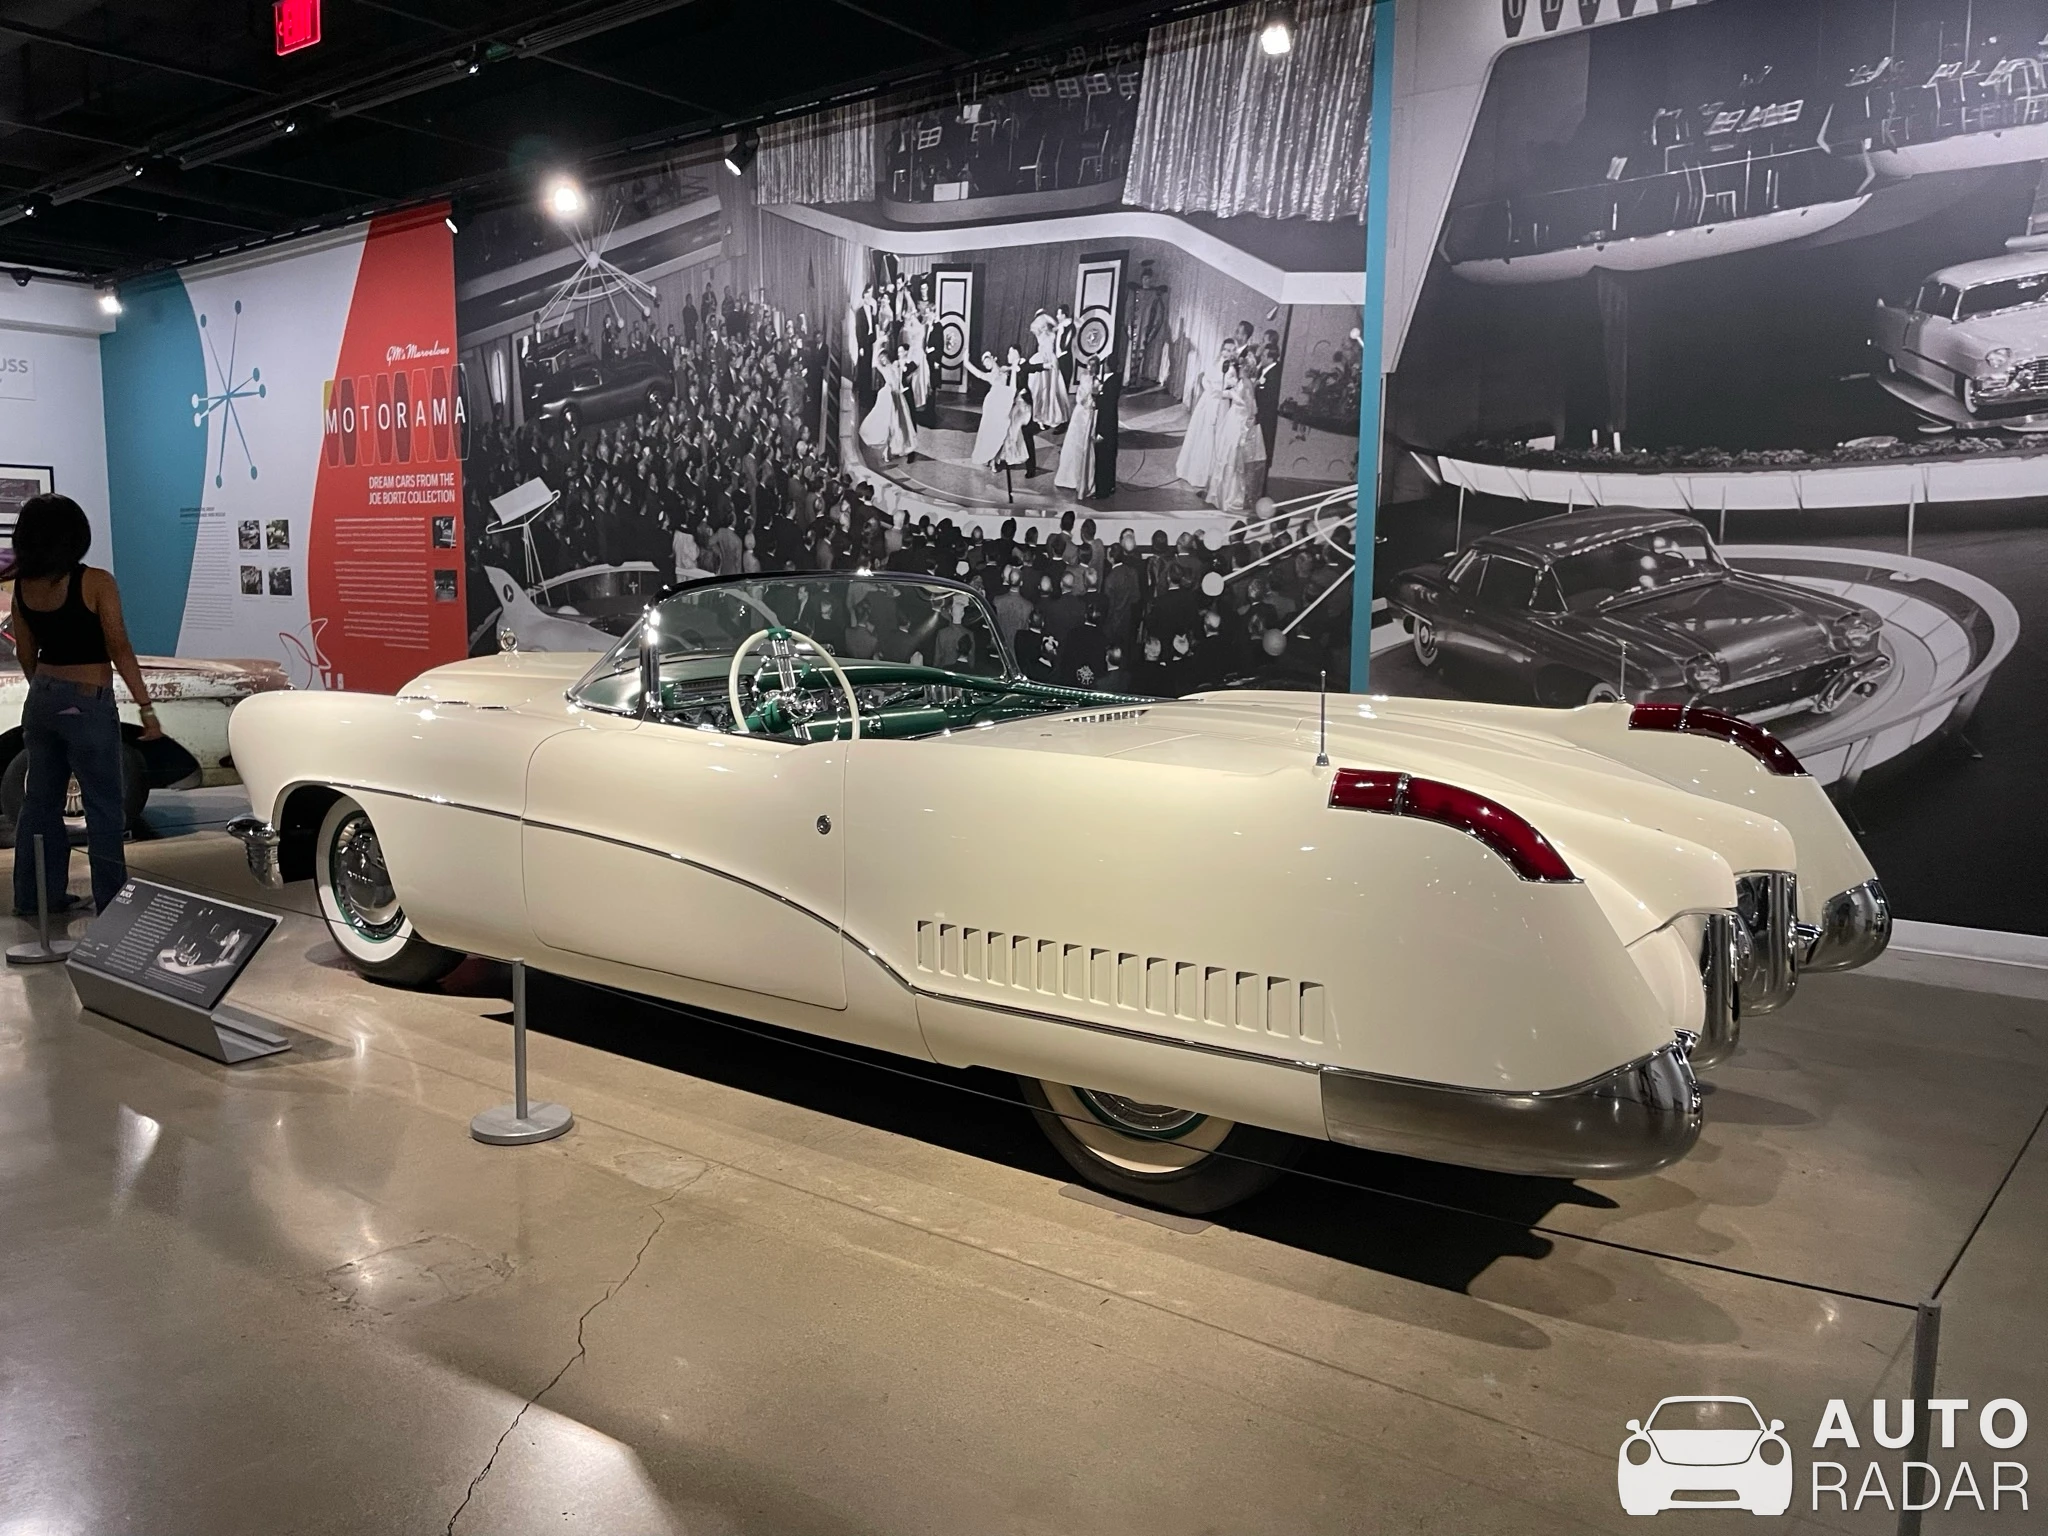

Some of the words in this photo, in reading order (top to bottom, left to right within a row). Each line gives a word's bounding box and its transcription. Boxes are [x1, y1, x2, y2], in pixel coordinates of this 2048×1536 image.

[405, 339, 450, 359] Marvelous
[325, 395, 467, 434] MOTORAMA
[368, 476, 395, 489] DREAM
[395, 474, 416, 488] CARS
[416, 473, 439, 487] FROM
[439, 472, 455, 486] THE
[368, 492, 382, 505] JOE
[382, 491, 407, 505] BORTZ
[407, 489, 456, 504] COLLECTION
